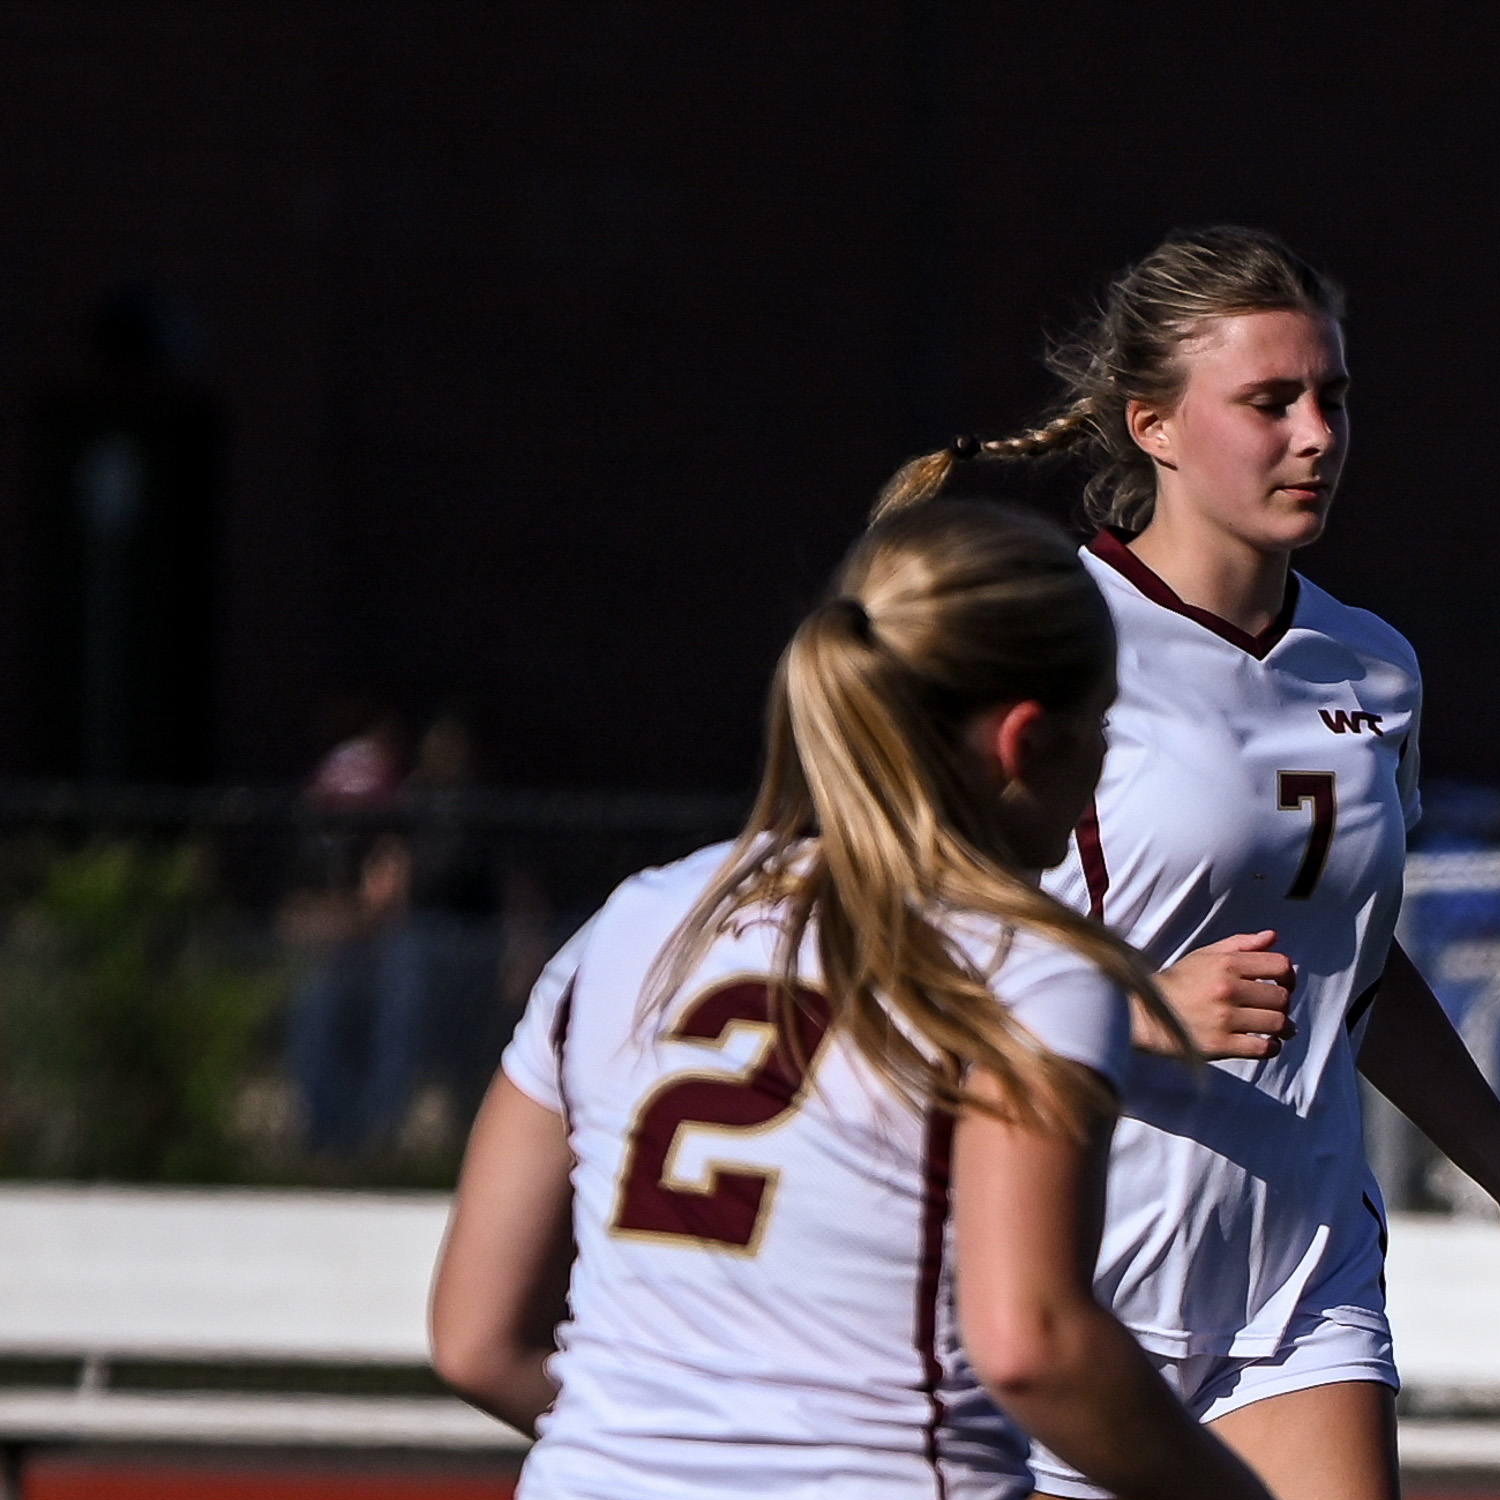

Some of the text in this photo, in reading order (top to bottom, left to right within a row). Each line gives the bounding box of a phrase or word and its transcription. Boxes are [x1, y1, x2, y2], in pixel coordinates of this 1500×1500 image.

[1317, 709, 1384, 737] WT
[1276, 769, 1338, 901] 7
[609, 973, 836, 1259] 2
